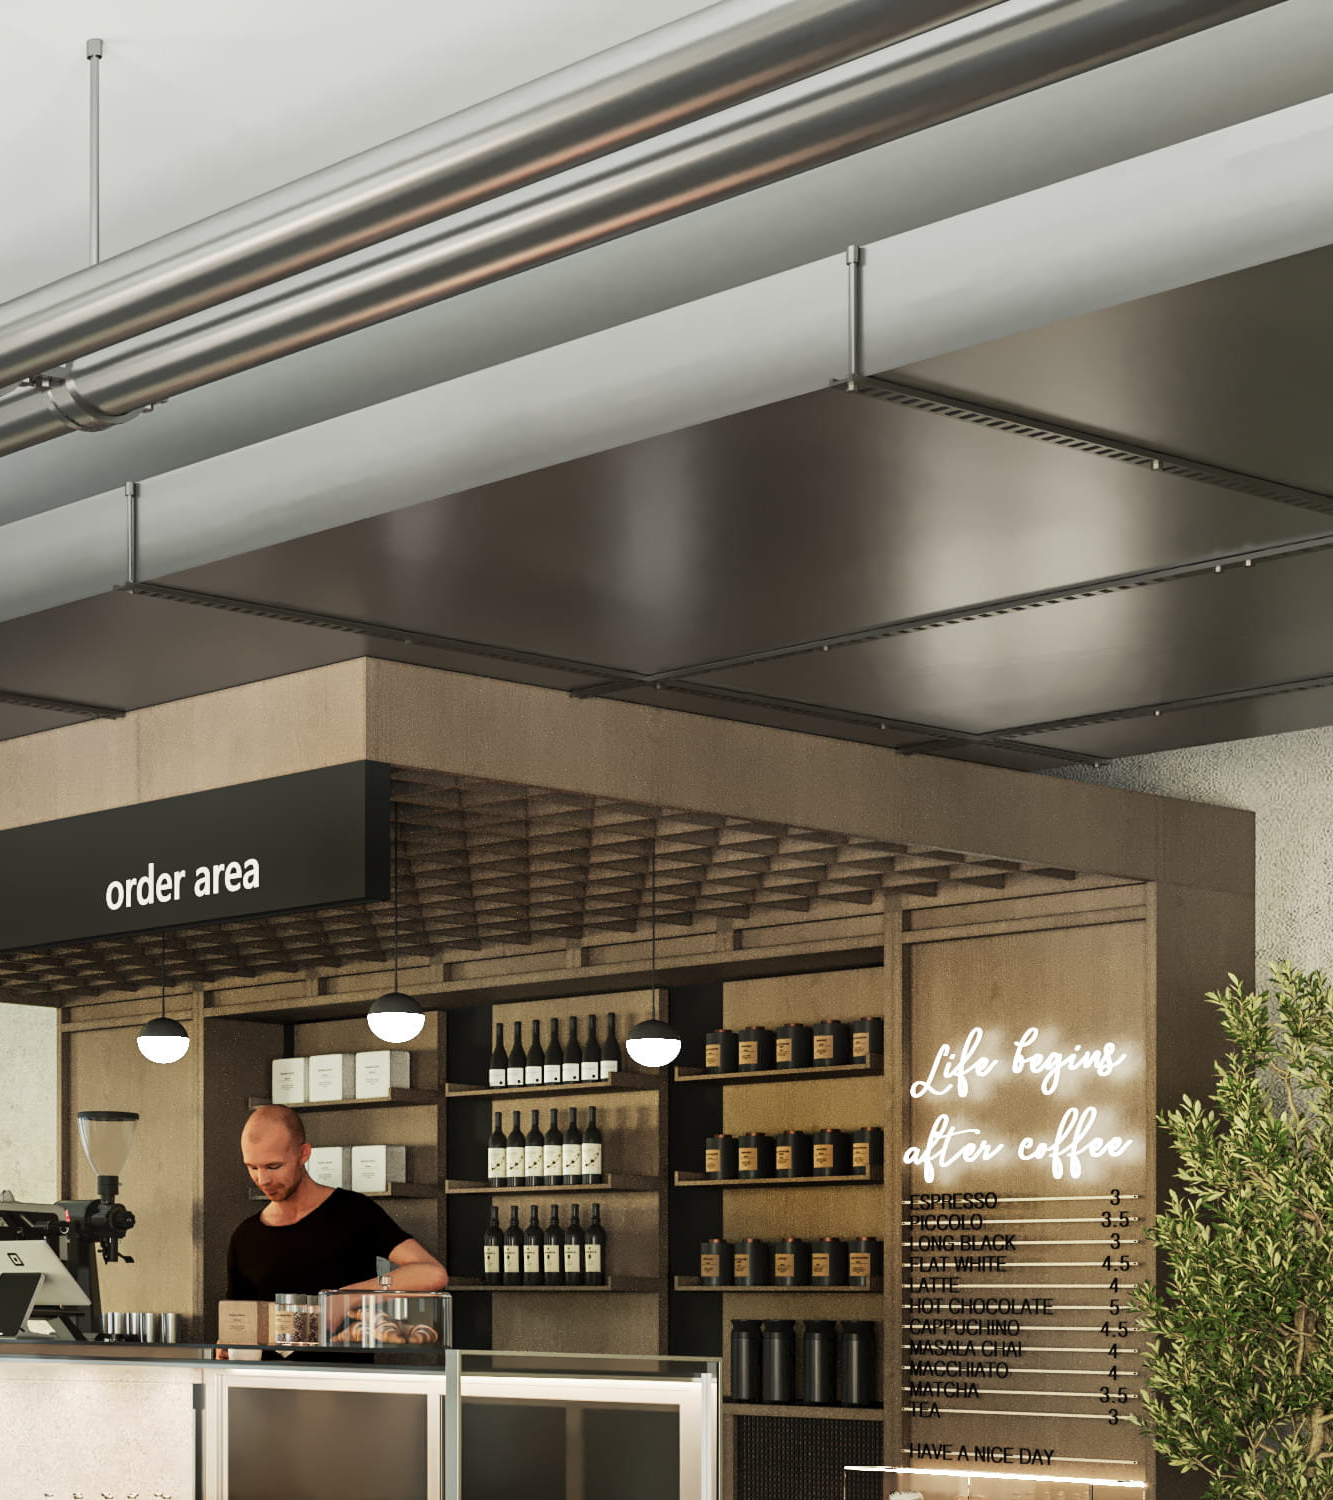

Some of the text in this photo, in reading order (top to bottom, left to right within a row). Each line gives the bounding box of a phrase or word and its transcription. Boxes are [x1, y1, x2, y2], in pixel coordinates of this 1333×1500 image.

[106, 859, 259, 910] order area
[909, 1026, 1127, 1098] Life begins
[902, 1107, 1133, 1183] after coffee
[910, 1189, 1120, 1210] ESPRESSO 3
[910, 1211, 1129, 1231] PICCOLO 3.5
[910, 1233, 1120, 1251] LONG BLACK 3
[910, 1255, 1130, 1272] FLAT WHITE 4.5
[910, 1277, 1118, 1293] LATTE 4
[909, 1298, 1119, 1315] HOT CHOCOLATE 5
[909, 1319, 1128, 1337] CAPPUCHINO 4.5
[910, 1339, 1117, 1359] MASALA CHAI 4
[910, 1360, 1117, 1380] MACCHIATO 4
[910, 1381, 1127, 1403] MATCHA 3.5
[910, 1402, 1118, 1425] TEA 3
[910, 1443, 1054, 1465] HAVE A NICE DAY
